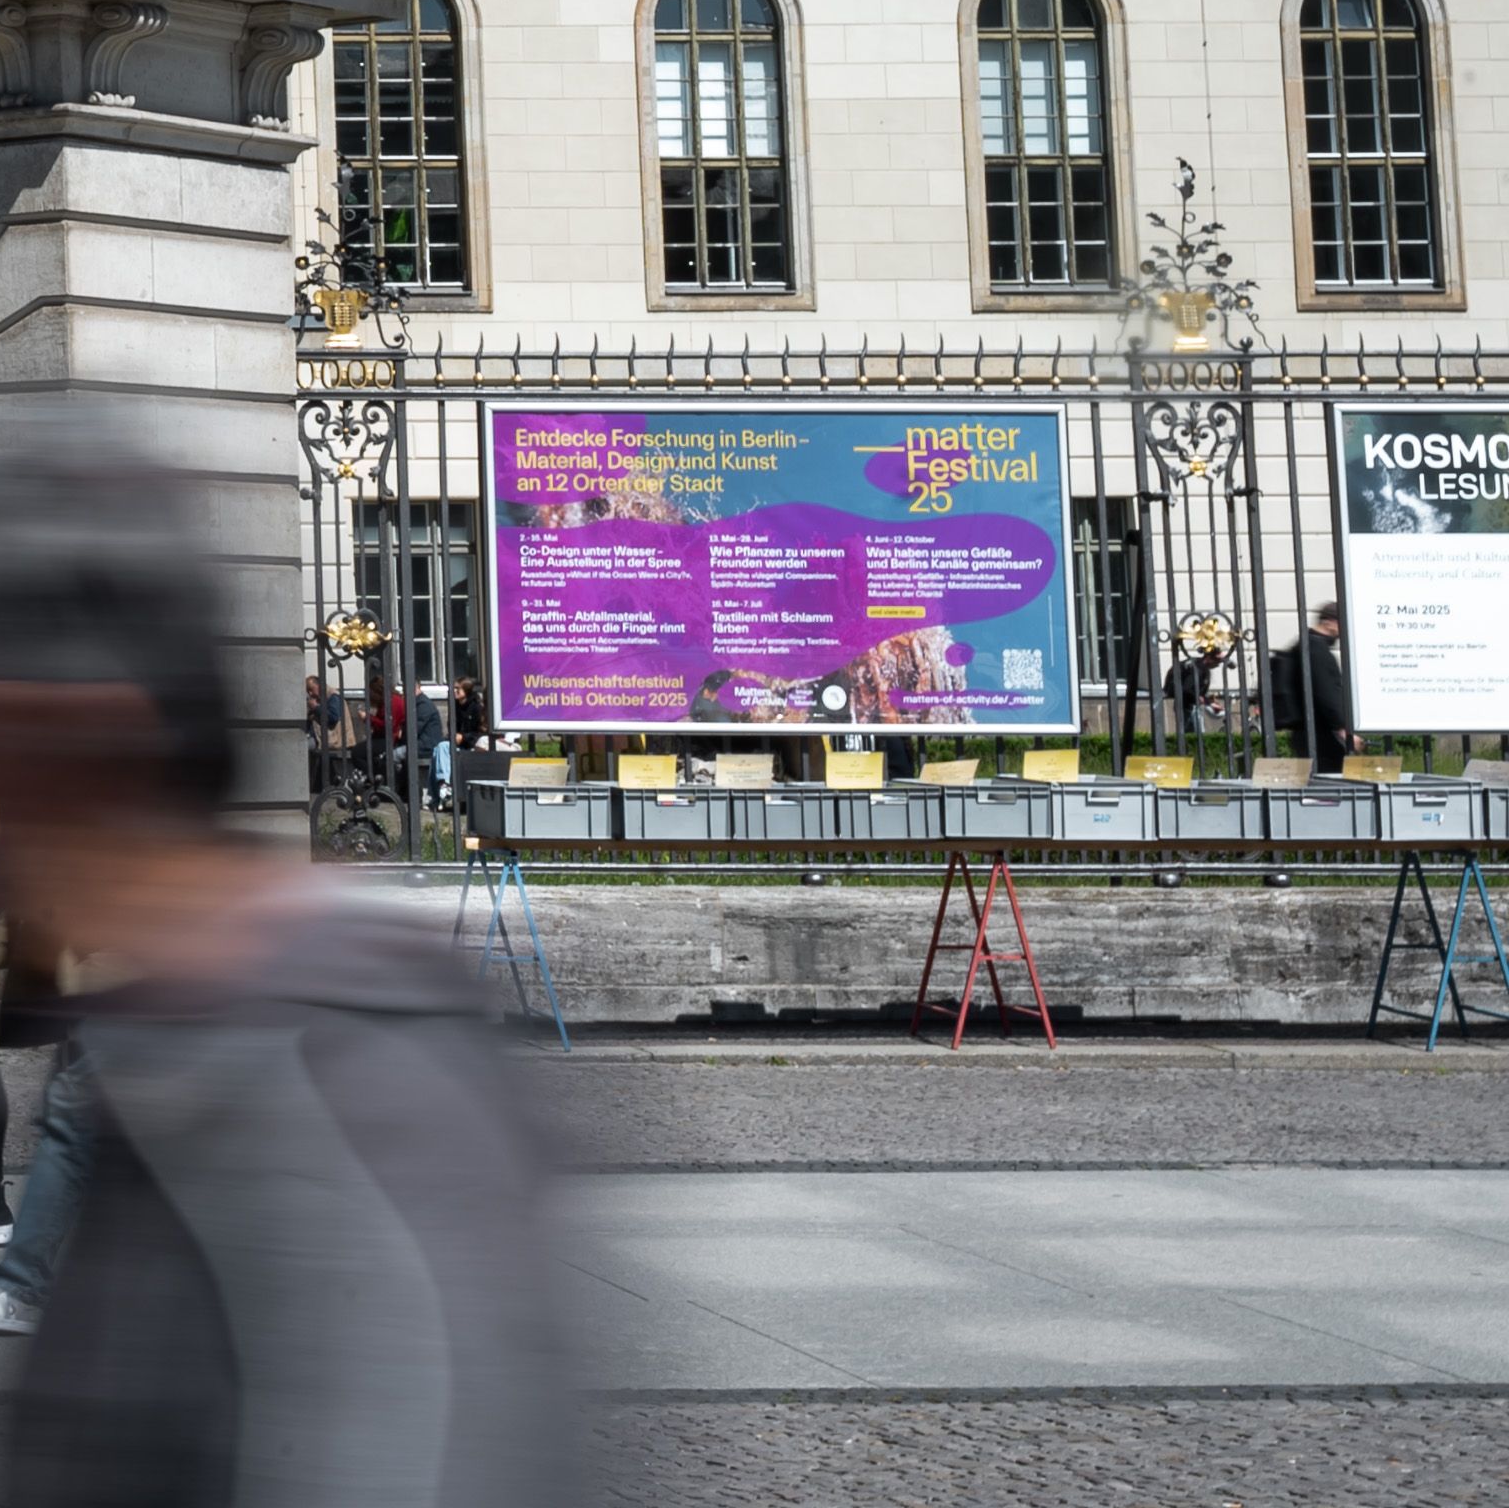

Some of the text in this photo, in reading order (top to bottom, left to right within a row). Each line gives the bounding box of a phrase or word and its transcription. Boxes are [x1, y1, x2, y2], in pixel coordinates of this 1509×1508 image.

[515, 429, 606, 447] Entdecke
[612, 429, 714, 451] Forschung
[720, 430, 737, 448] in
[516, 451, 777, 473] Material, Design und Kunst
[907, 451, 1037, 482] Festival
[517, 474, 724, 492] an 12 Orten der Stadt
[908, 482, 953, 513] 25
[543, 534, 558, 542] Mai
[520, 546, 580, 557] Co-Design
[583, 547, 611, 556] unter
[709, 546, 845, 557] Wie Pflanzen zu unseren
[866, 547, 1012, 558] Was haben unsere Gefäße
[1448, 552, 1471, 562] und
[520, 557, 681, 569] Eine Ausstellung in der Spree
[710, 558, 807, 568] Freunden werden
[867, 559, 1042, 571] und Berlins Kanäle gemeinsam?
[521, 571, 565, 580] Ausstellung
[546, 599, 561, 608] Mai
[1397, 605, 1418, 615] Mai
[1422, 605, 1450, 615] 2025
[523, 611, 655, 623] Paraffin Abfallmaterial,
[712, 612, 833, 622] Textilien mit Schlamm
[523, 623, 685, 634] das uns durch die Finger rinnt
[713, 623, 749, 633] färben
[523, 675, 684, 688] Wissenschaftsfestival
[734, 687, 773, 696] Matters
[523, 692, 688, 708] April bis Oktober 2025
[741, 697, 788, 707] of Activity
